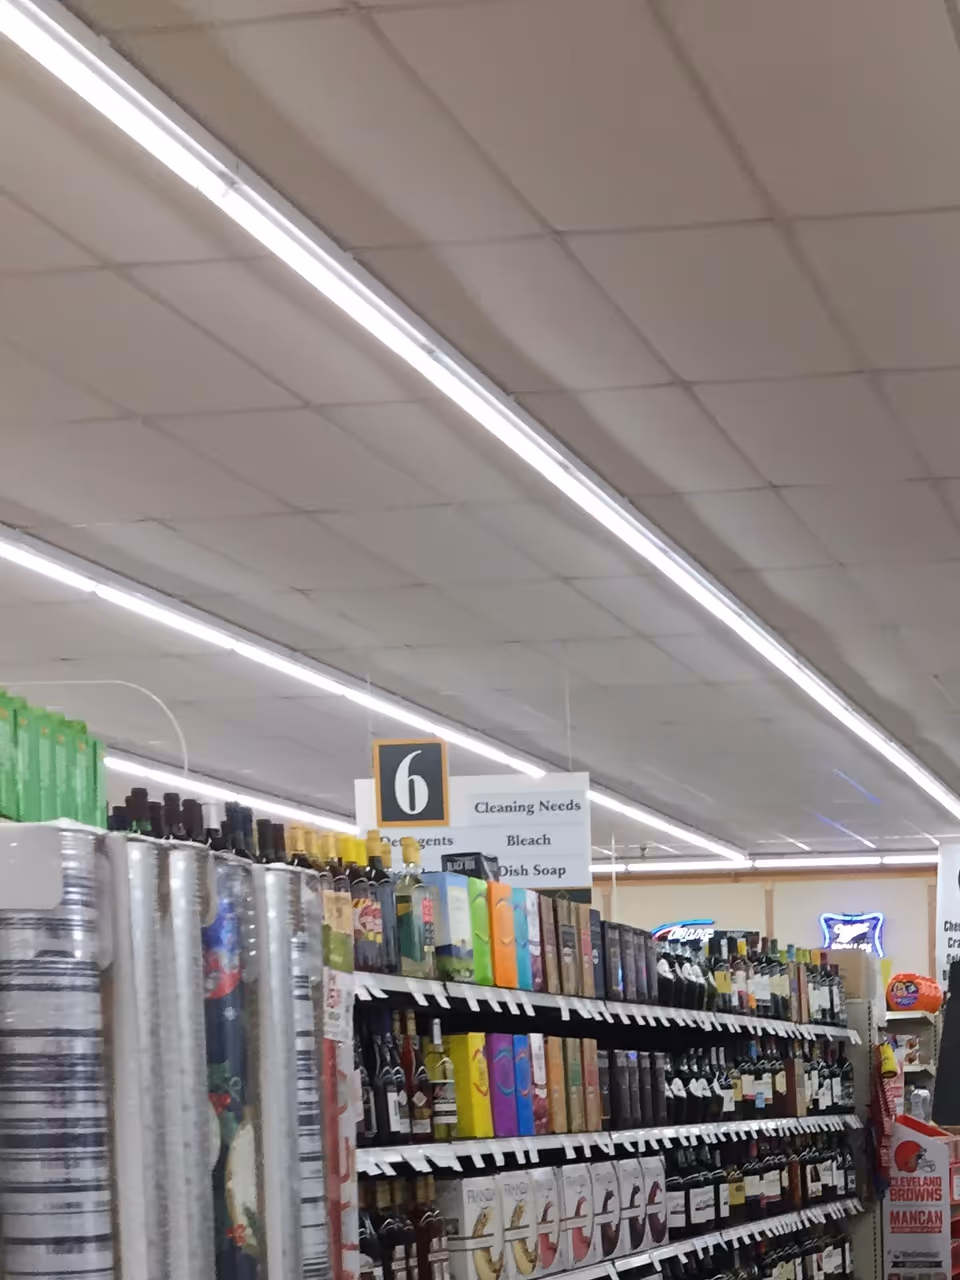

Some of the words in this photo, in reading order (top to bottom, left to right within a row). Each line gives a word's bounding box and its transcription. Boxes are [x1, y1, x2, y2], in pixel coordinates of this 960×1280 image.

[395, 750, 429, 815] 6
[474, 801, 535, 815] Cleaning
[538, 799, 582, 812] Needs
[507, 834, 551, 846] Bleach
[499, 865, 529, 877] Dish
[533, 865, 566, 878] Soap
[890, 1176, 942, 1187] CLEVELAND
[890, 1188, 942, 1202] BROWNS
[890, 1210, 943, 1225] MANCAN
